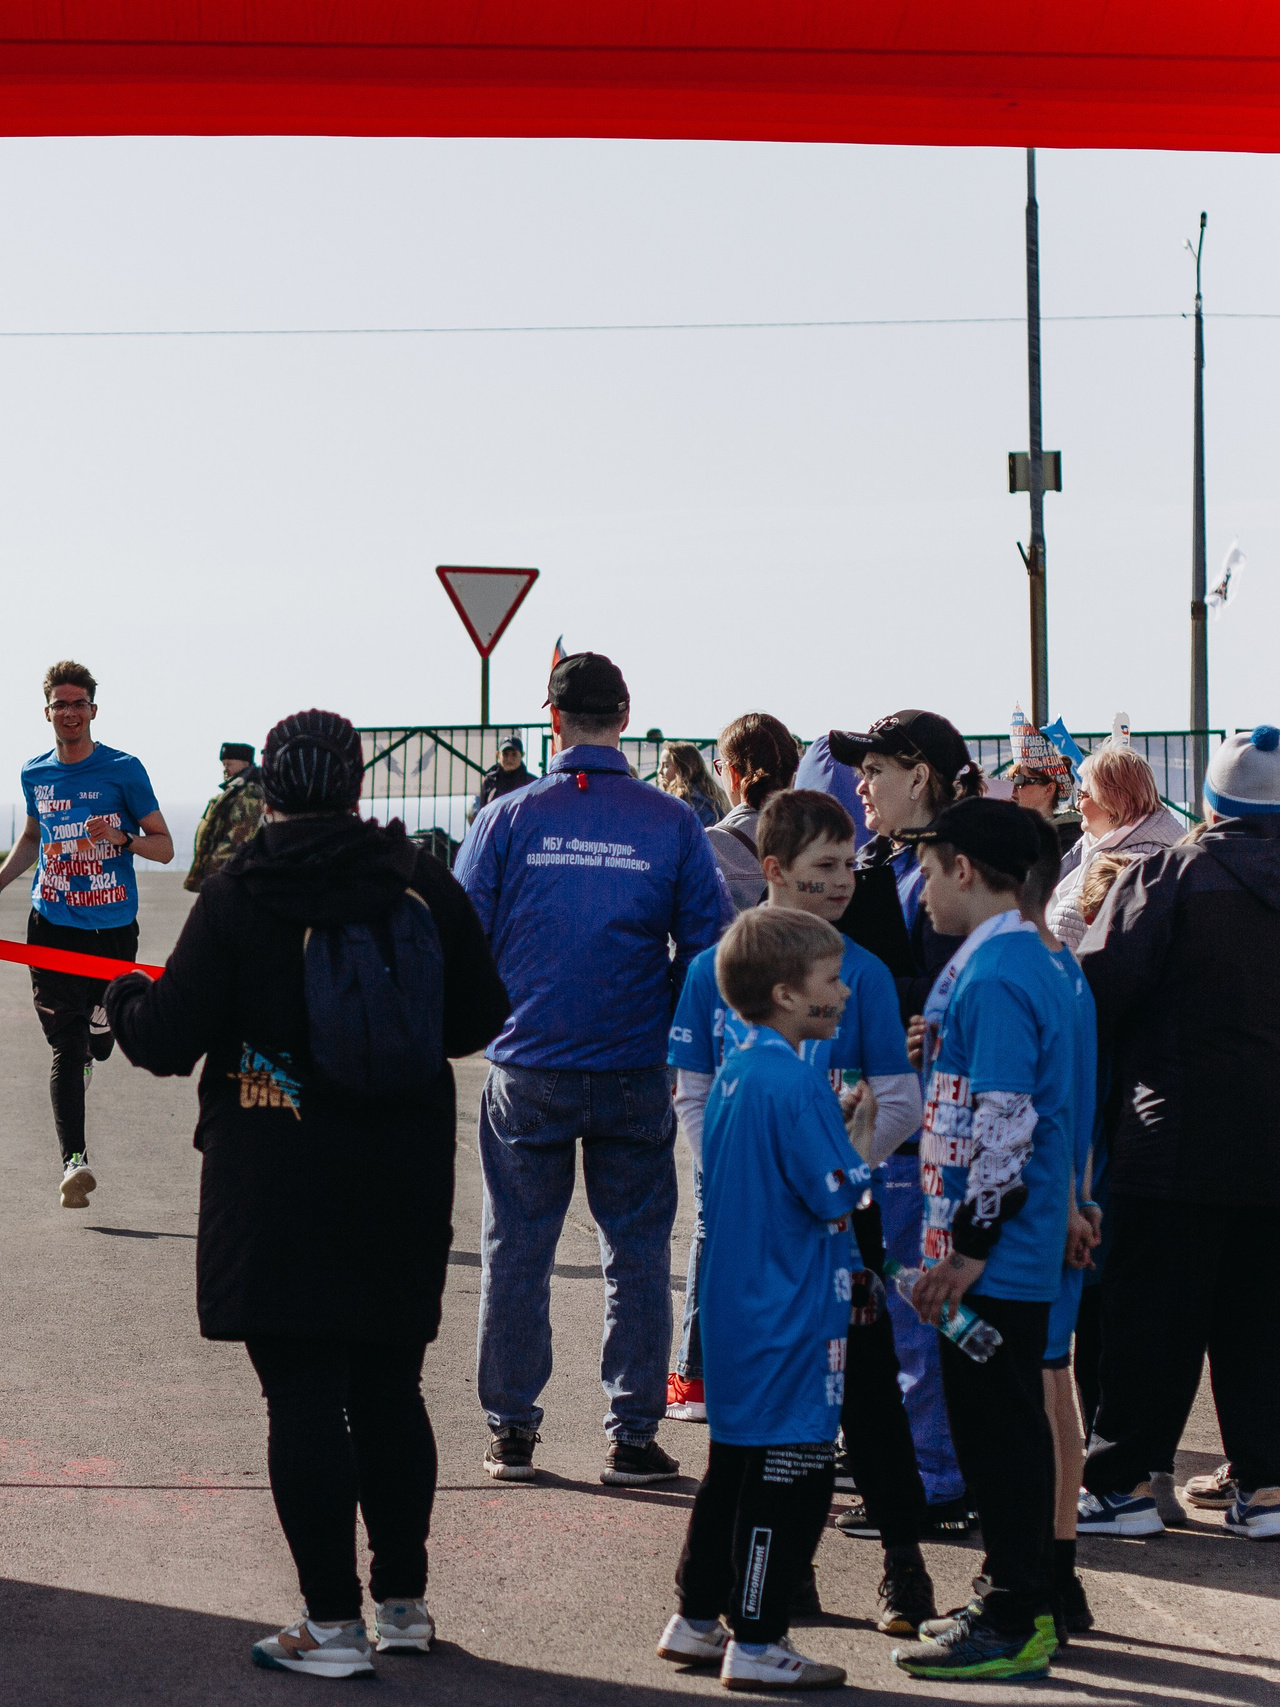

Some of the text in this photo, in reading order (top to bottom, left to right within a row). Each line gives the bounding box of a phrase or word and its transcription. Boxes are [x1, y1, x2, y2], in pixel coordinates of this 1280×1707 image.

[52, 822, 83, 840] 20007
[543, 836, 636, 856] МБУ «Физкультурно-
[526, 853, 651, 872] оздоровительный комплекс»
[90, 871, 117, 891] 2024
[65, 884, 127, 907] #ЕДИНСТВО
[746, 1545, 766, 1612] #nocomment
